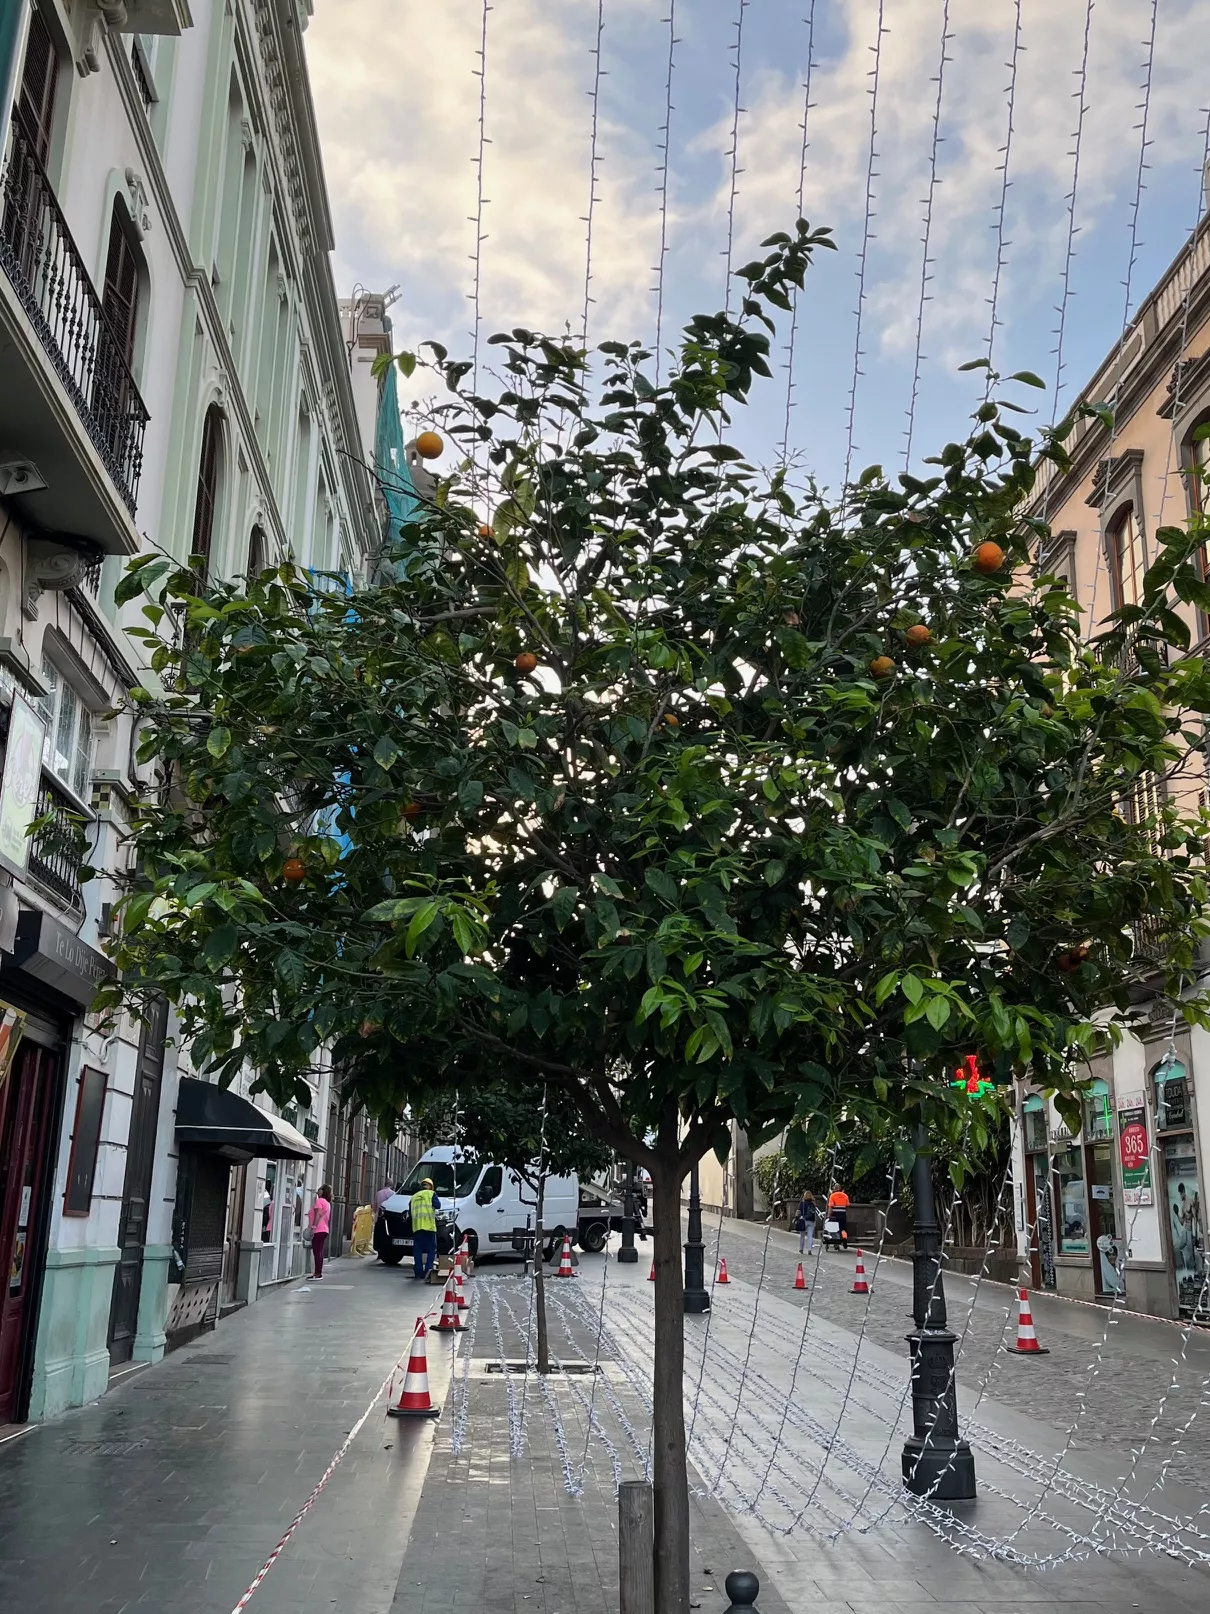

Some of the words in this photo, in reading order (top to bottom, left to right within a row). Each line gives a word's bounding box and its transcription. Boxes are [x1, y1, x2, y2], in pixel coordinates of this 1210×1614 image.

[56, 931, 65, 957] Te
[65, 939, 74, 963] Lo
[75, 946, 88, 976] Dije
[1125, 1133, 1144, 1154] 365
